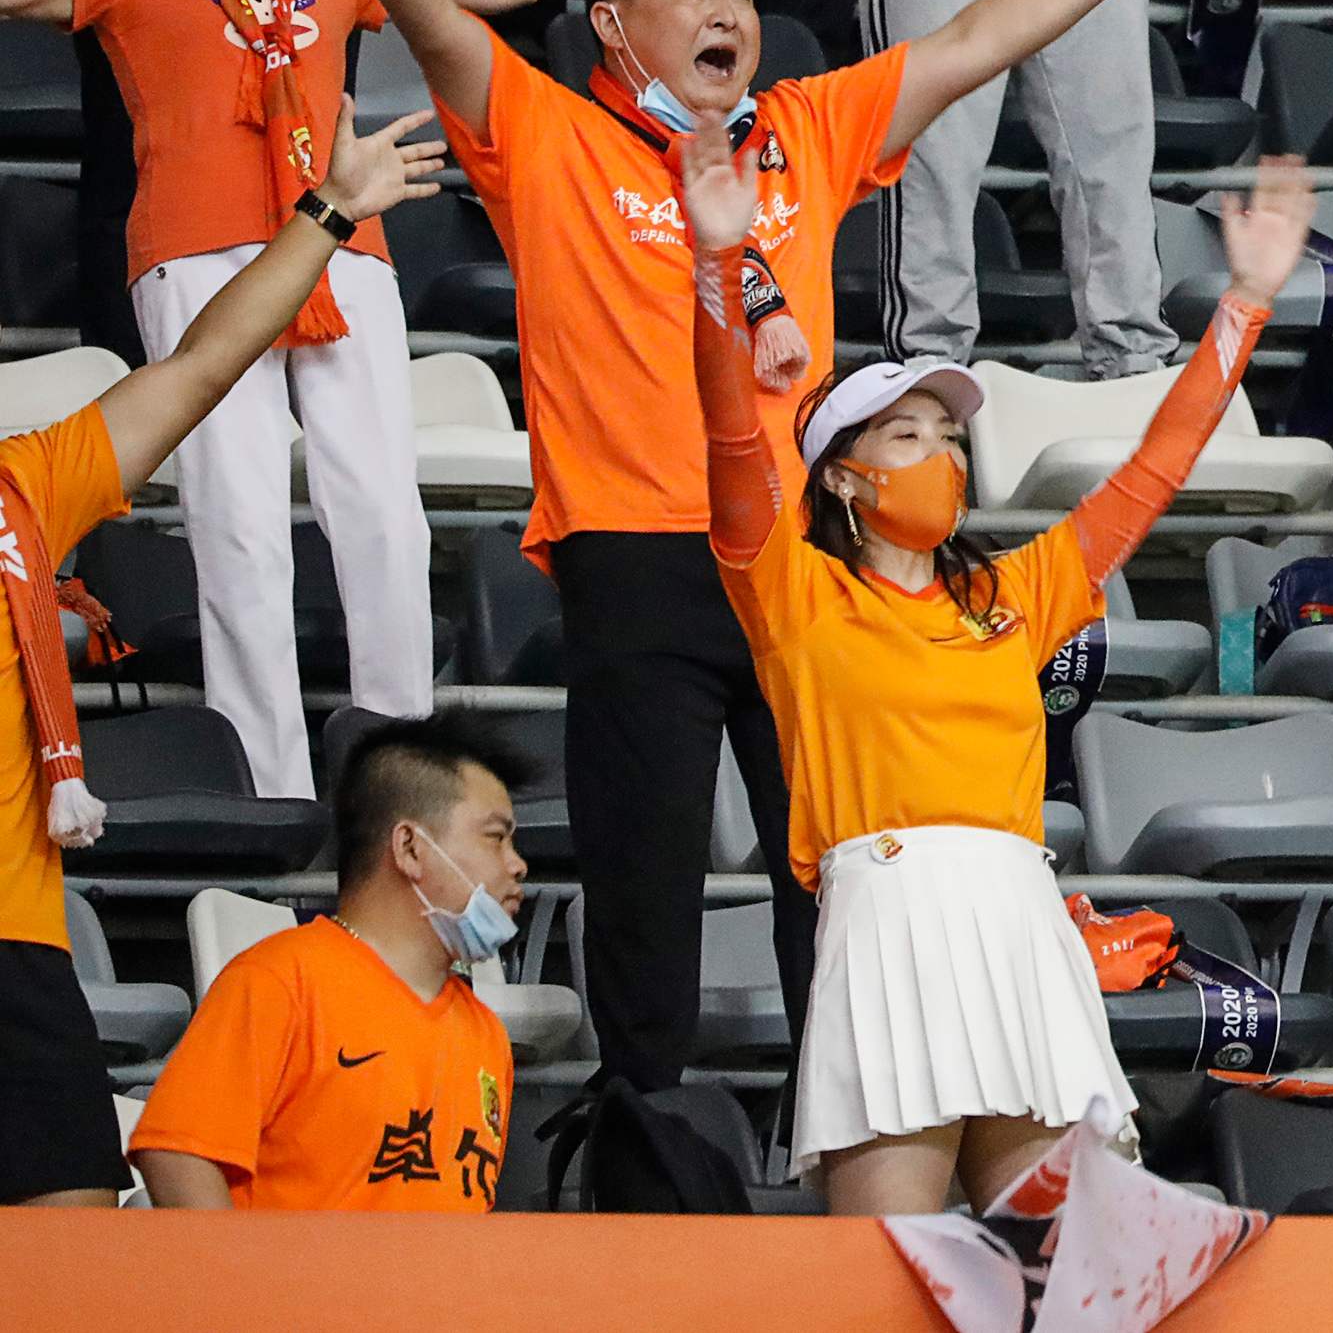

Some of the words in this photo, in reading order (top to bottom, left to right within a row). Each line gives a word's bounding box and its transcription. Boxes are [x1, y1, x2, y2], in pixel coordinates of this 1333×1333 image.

[1077, 624, 1090, 651] Pin
[1051, 638, 1073, 681] 202
[1222, 986, 1242, 1038] 2020
[1245, 1010, 1257, 1038] 2020
